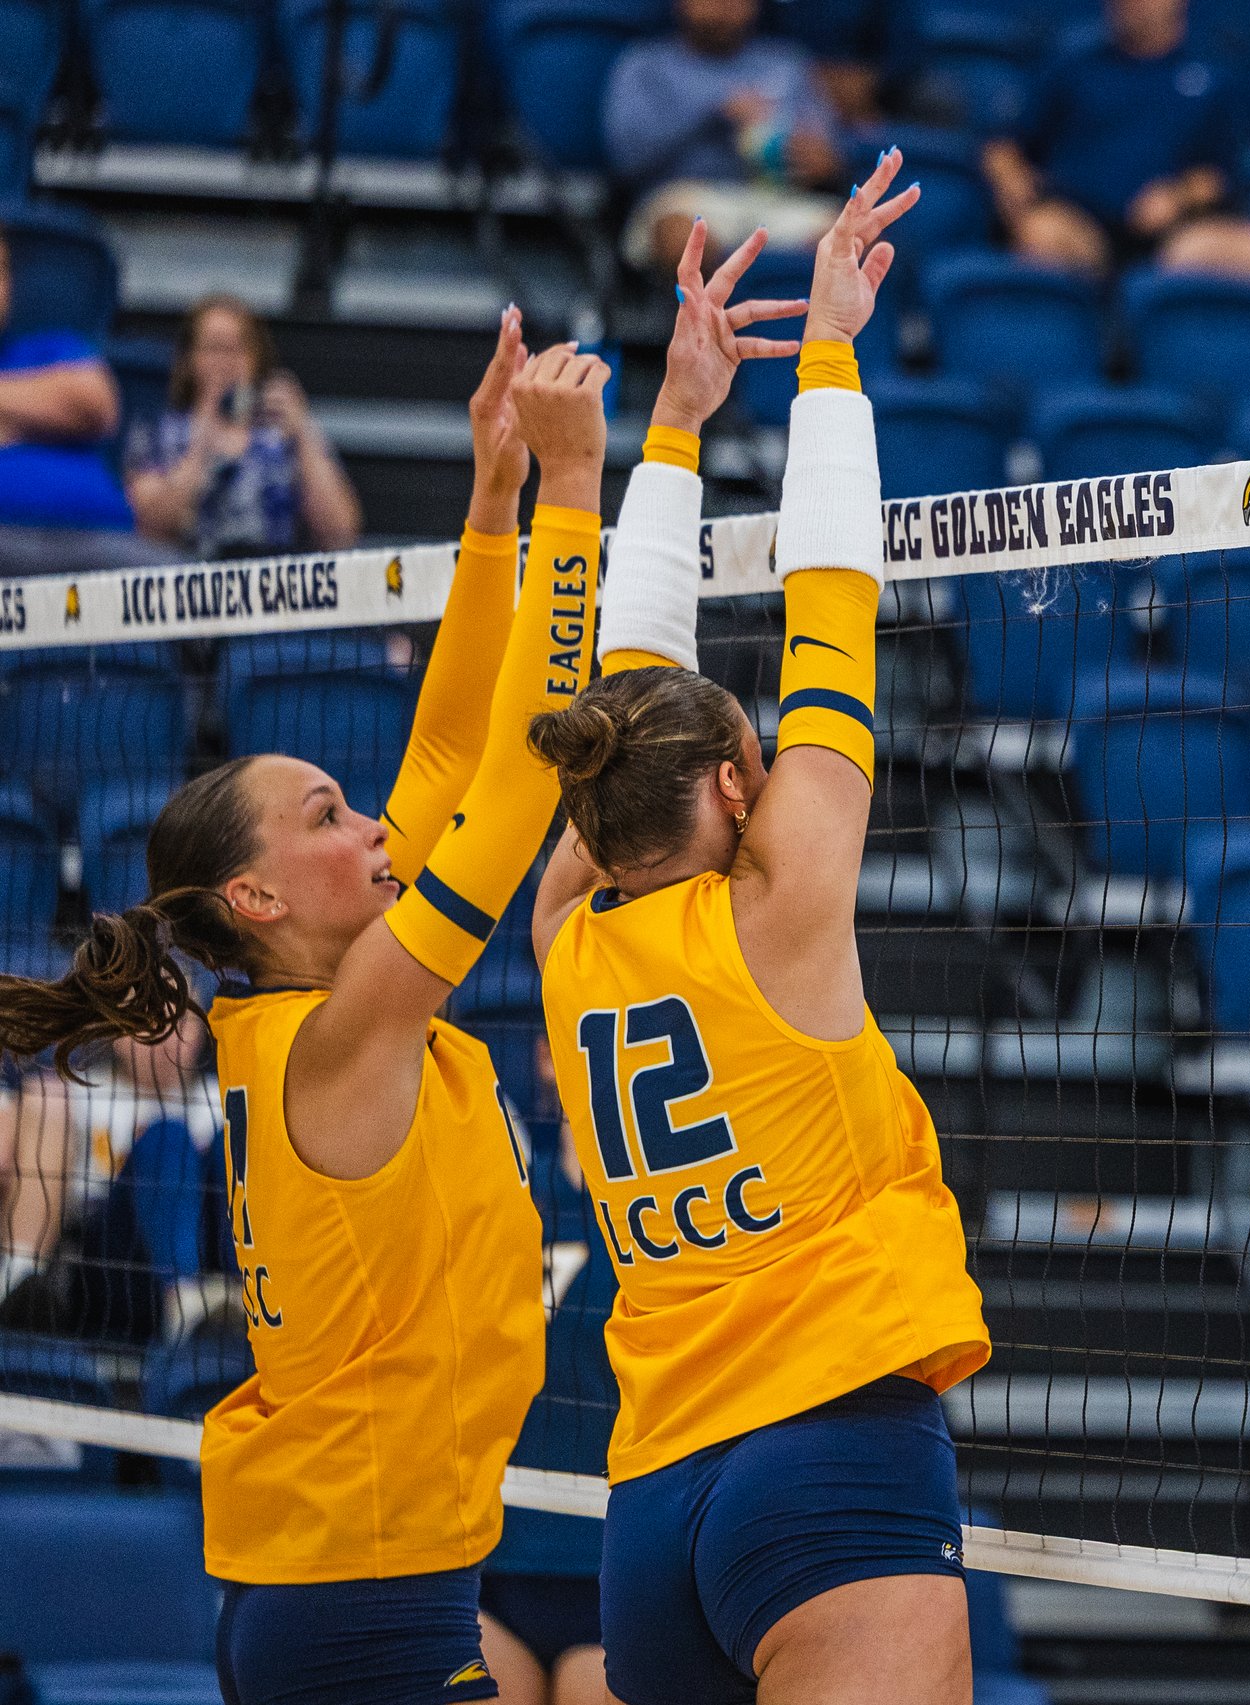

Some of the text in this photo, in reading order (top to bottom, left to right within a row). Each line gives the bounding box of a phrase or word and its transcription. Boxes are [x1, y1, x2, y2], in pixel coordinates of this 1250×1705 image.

[932, 487, 1049, 557] GOLDEN
[1057, 473, 1174, 546] EAGLES
[259, 562, 338, 613] EAGLES
[547, 555, 587, 695] EAGLES
[577, 994, 739, 1182] 12
[599, 1164, 782, 1266] LCCC
